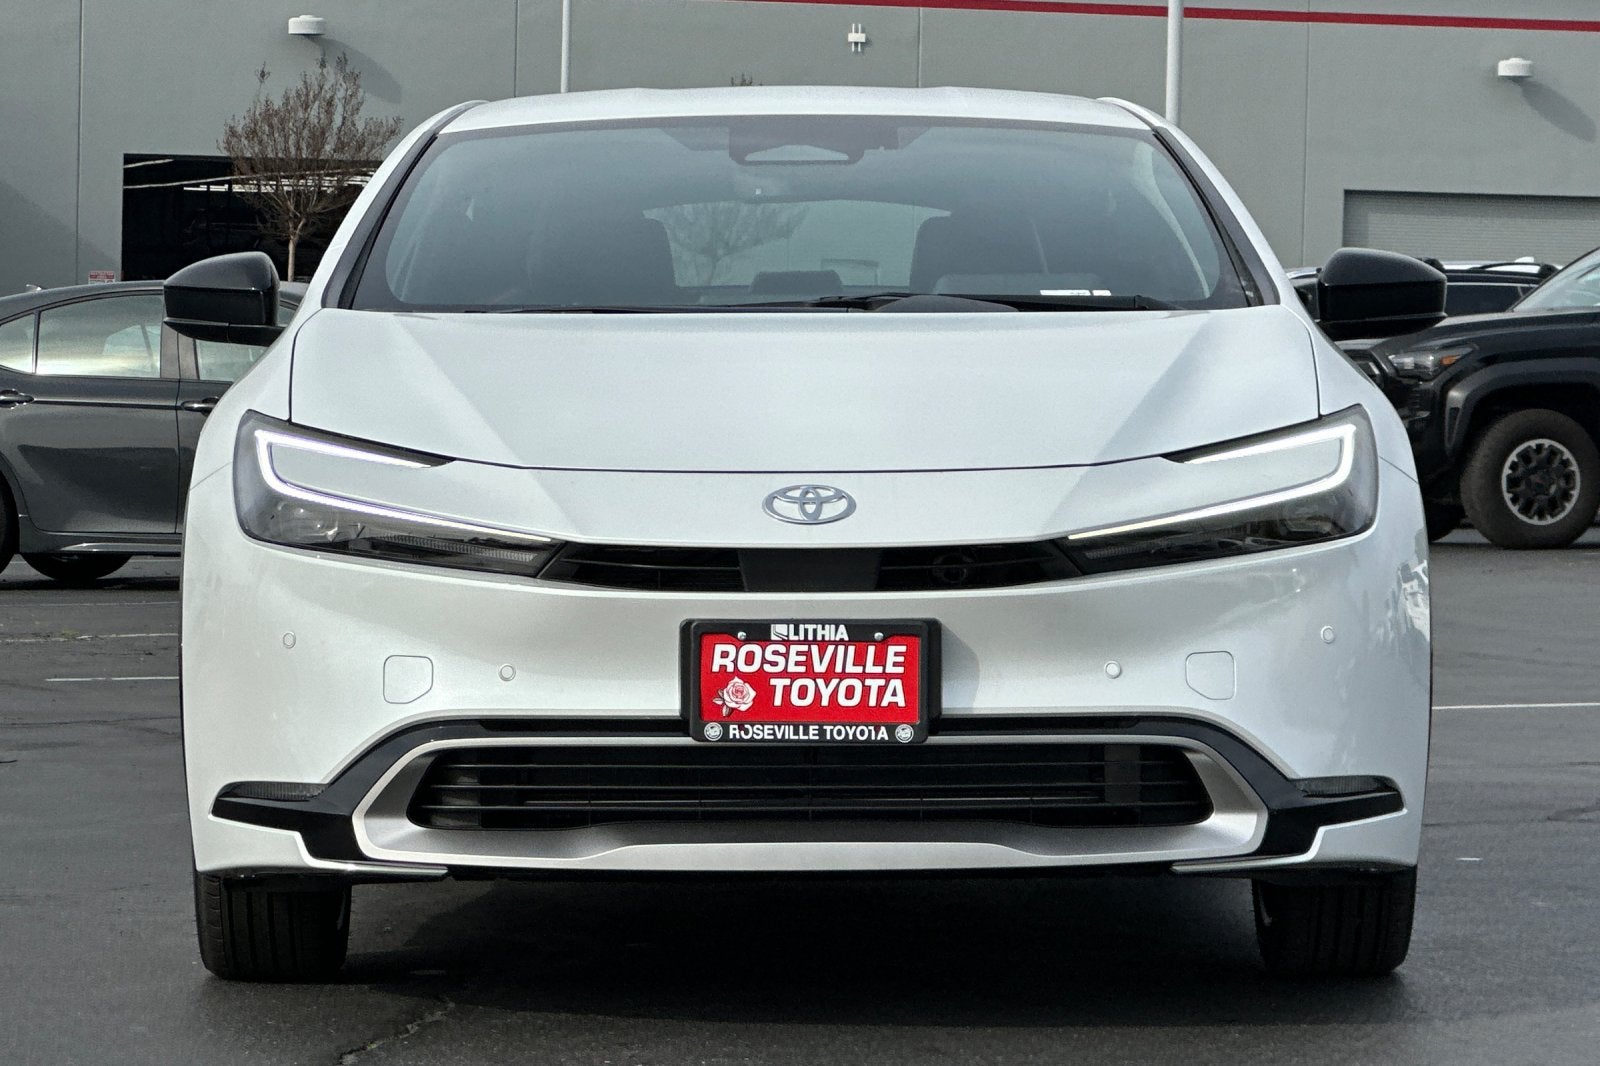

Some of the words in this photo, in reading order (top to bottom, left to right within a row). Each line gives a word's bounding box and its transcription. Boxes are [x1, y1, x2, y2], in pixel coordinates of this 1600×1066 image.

[788, 624, 849, 641] LITHIA
[711, 643, 908, 674] ROSEVILLE
[769, 678, 906, 707] TOYOTA
[729, 725, 820, 740] ROSEVILLE
